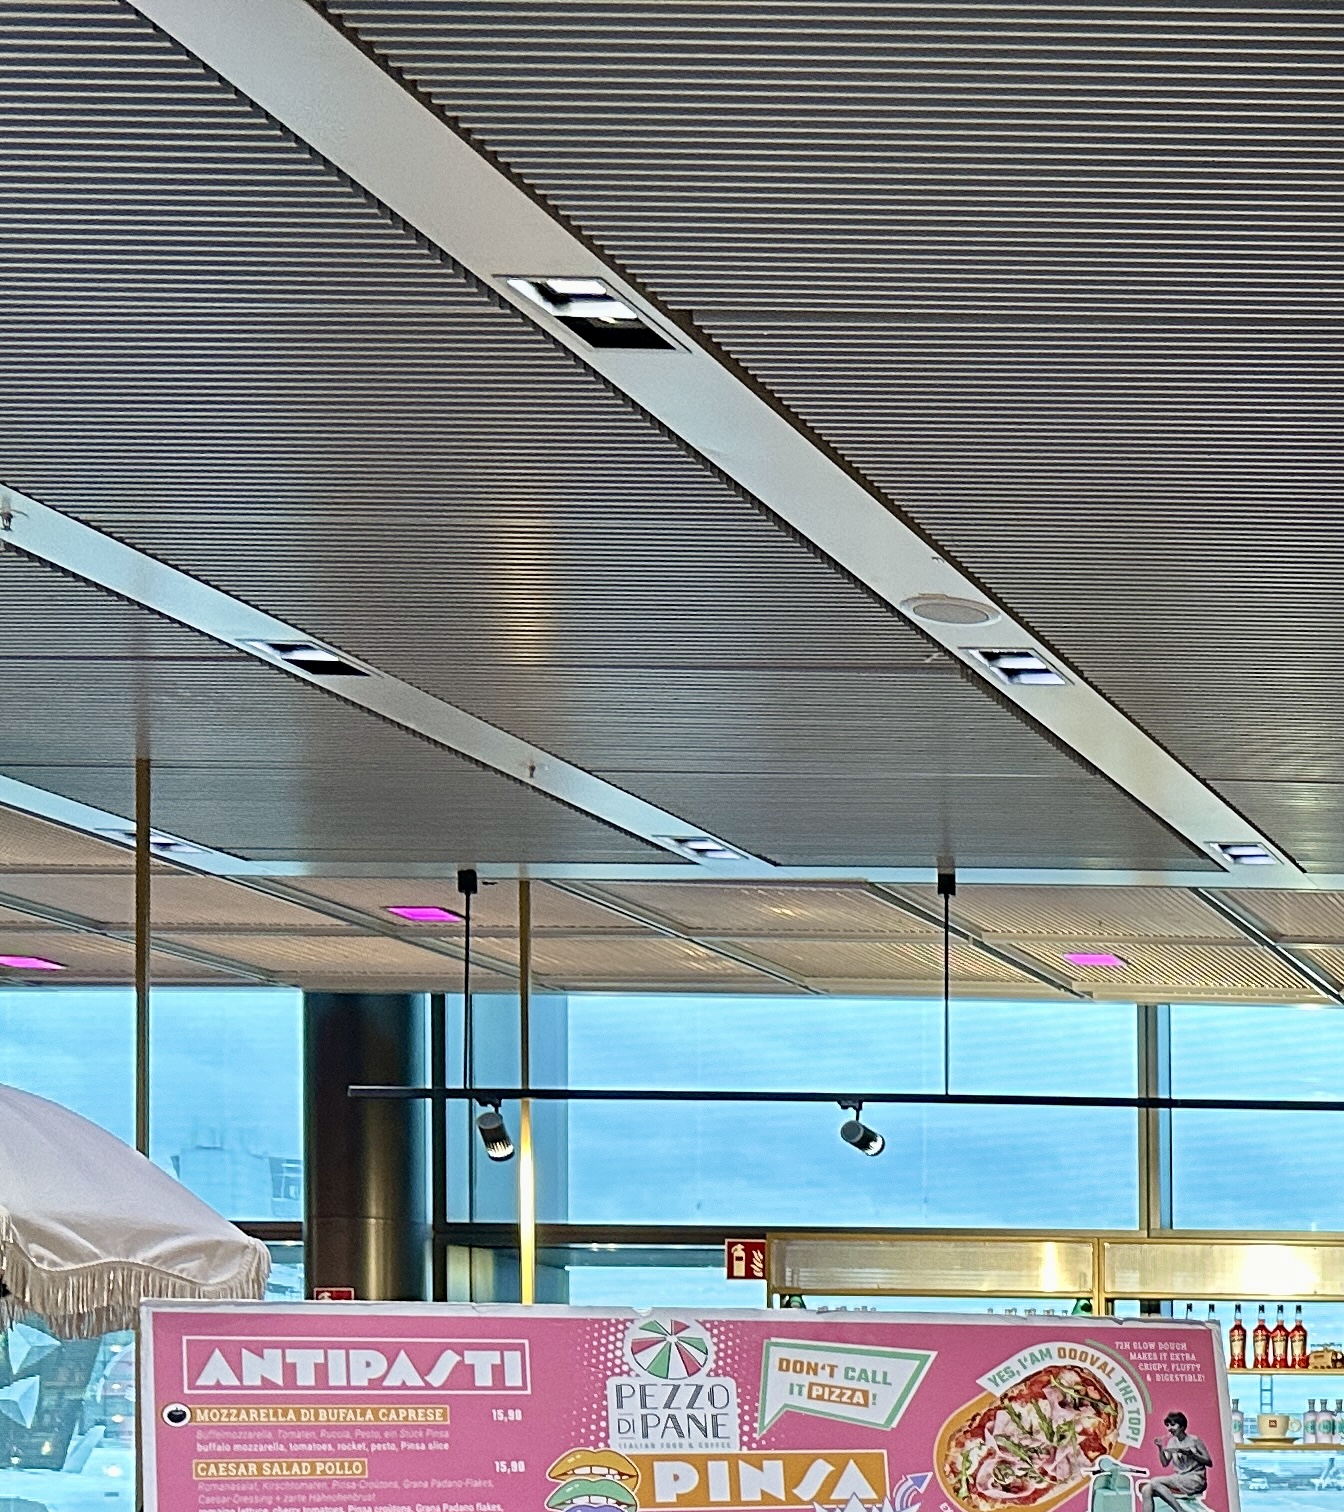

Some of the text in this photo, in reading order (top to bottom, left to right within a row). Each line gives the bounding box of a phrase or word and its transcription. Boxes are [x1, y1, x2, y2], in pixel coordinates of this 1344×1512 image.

[195, 1347, 523, 1387] ANTIPASTI
[844, 1367, 892, 1386] CALL
[789, 1383, 866, 1405] IT PIZZA
[987, 1364, 1021, 1388] YES,
[1114, 1376, 1137, 1406] THE
[1126, 1409, 1141, 1441] TOP!
[196, 1409, 522, 1422] MOZZARELLA DI BUFALA CAPRESE 15,90
[615, 1383, 731, 1439] PEZZO DI PANE
[197, 1461, 525, 1476] CAESAR SALAD POLLO 15,90
[653, 1459, 878, 1503] PINSA
